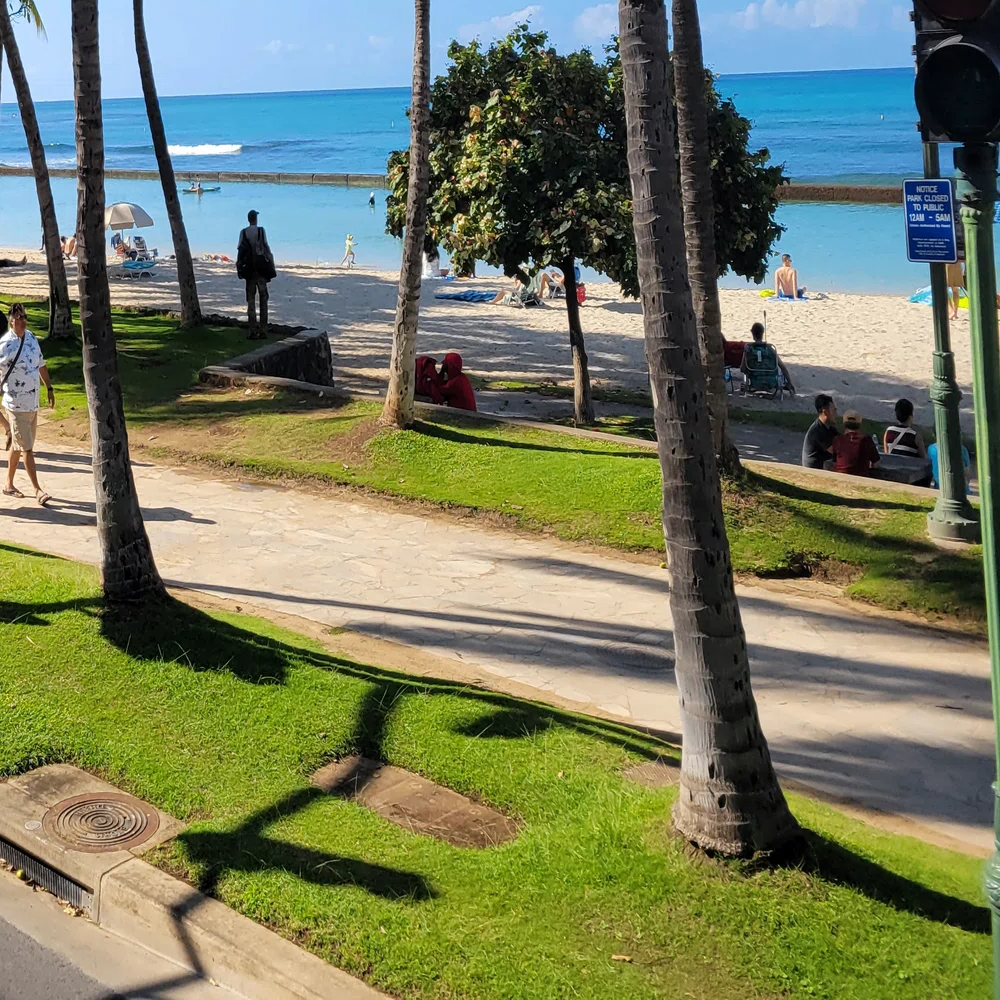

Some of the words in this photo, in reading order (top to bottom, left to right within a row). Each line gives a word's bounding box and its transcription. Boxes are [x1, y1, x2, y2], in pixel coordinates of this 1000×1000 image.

[913, 203, 921, 211] TO
[923, 203, 944, 211] PUBLIC
[909, 213, 925, 222] 12AM
[935, 213, 951, 222] 5AM
